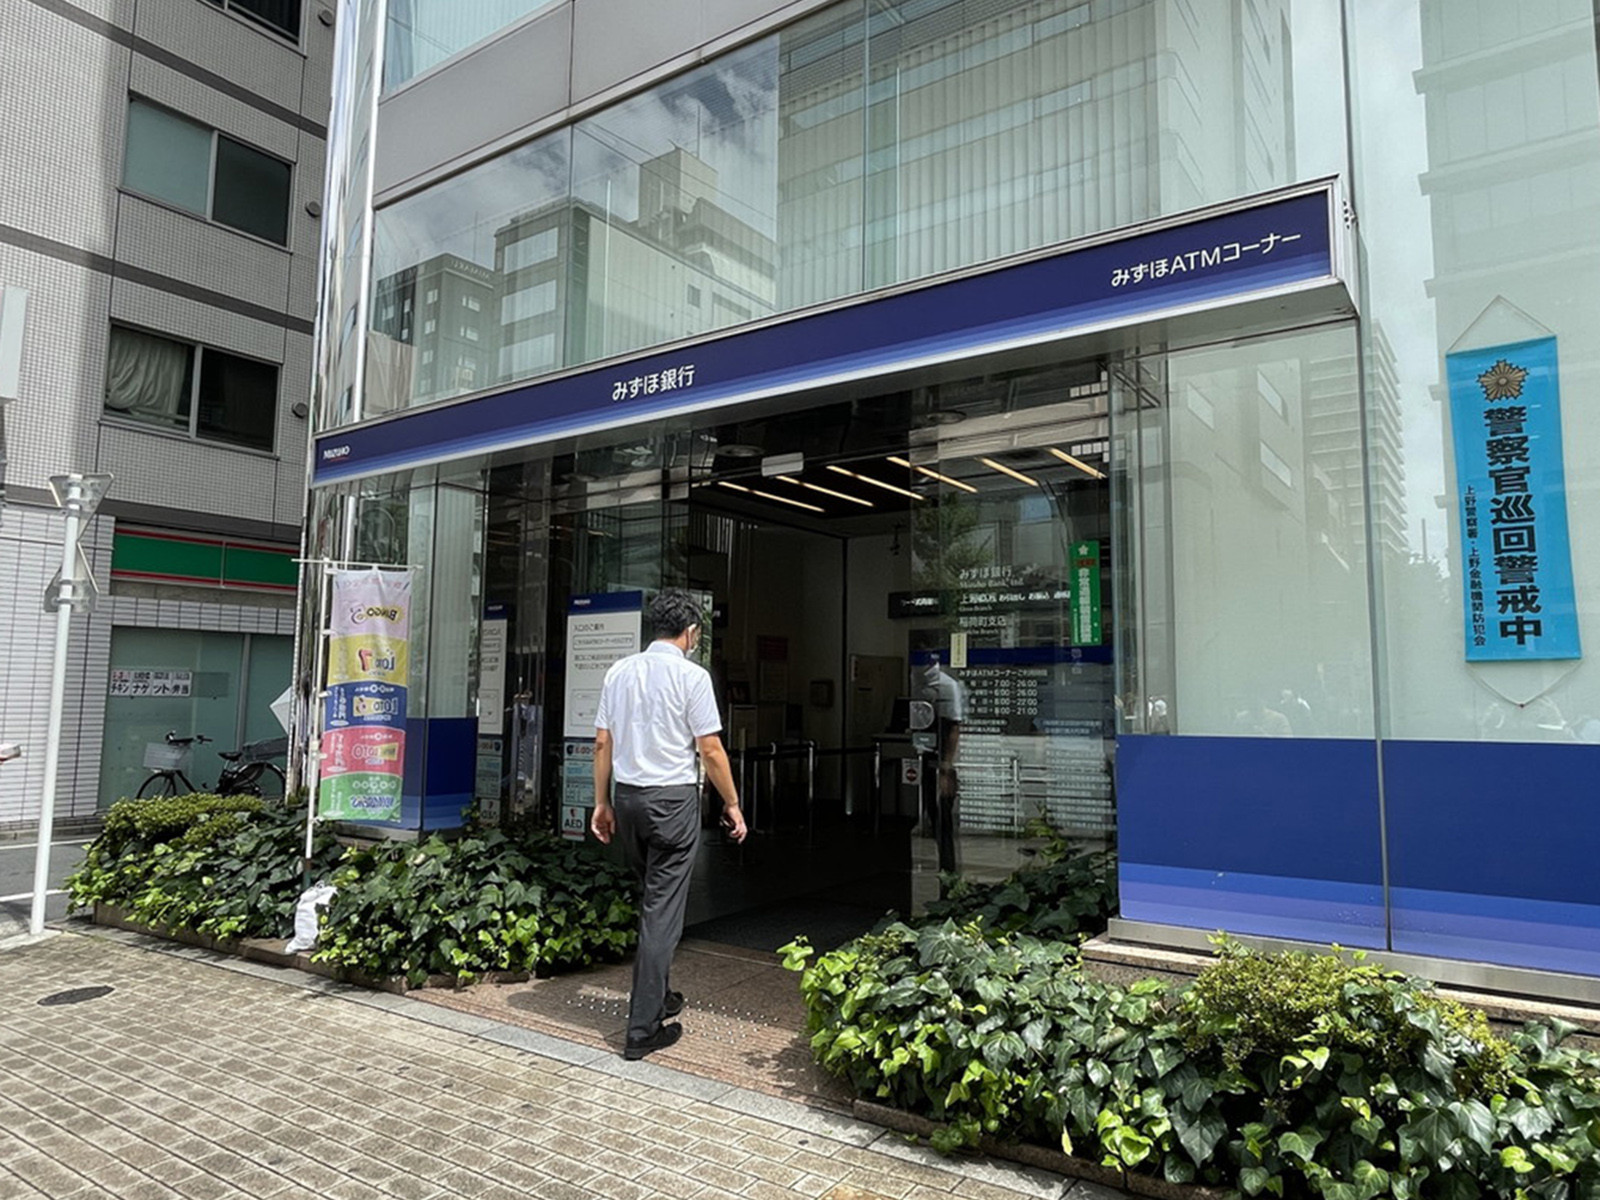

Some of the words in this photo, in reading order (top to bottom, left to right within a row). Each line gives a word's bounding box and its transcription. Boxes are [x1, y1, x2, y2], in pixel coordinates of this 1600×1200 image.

[1111, 232, 1301, 287] みずほATMコーナー
[612, 364, 695, 401] みずほ銀行
[1484, 406, 1542, 645] 警察官巡回警戒中
[564, 818, 583, 829] AED
